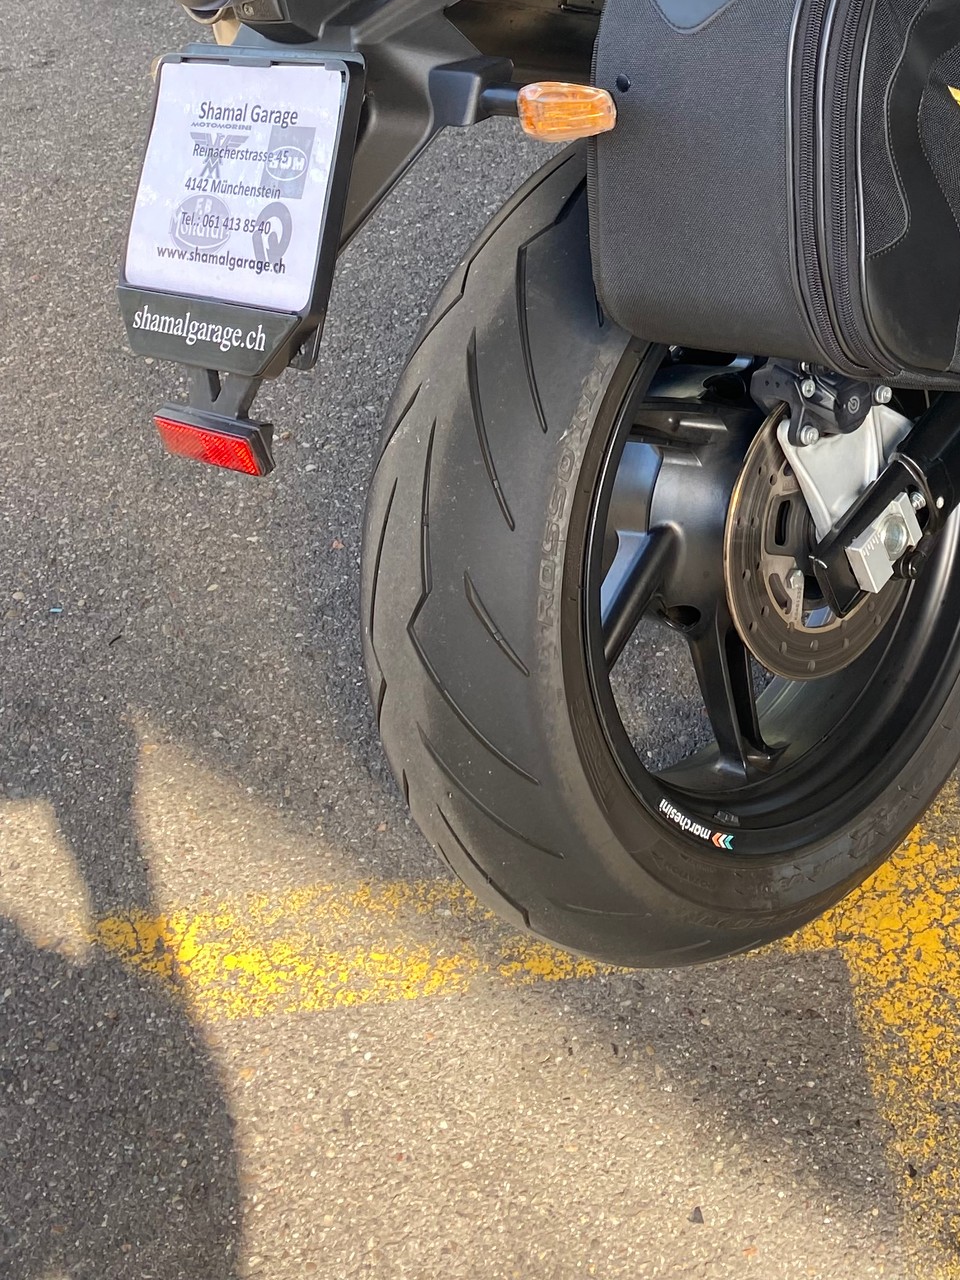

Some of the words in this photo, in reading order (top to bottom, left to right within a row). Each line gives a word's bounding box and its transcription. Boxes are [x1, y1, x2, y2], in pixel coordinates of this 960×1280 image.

[198, 101, 248, 122] Shamal
[251, 105, 298, 129] Garage
[192, 144, 273, 163] Reinacherstrasse
[275, 150, 289, 164] 45
[185, 177, 209, 192] 4142
[210, 179, 281, 199] Münchenstein
[181, 211, 201, 227] Tel.:
[202, 214, 220, 229] 061
[222, 217, 241, 232] 413
[242, 219, 256, 233] 85
[257, 221, 271, 235] 40
[156, 246, 286, 275] www.shamalgarage.ch
[132, 304, 266, 352] shamalgarage.ch
[659, 798, 712, 840] marchesini
